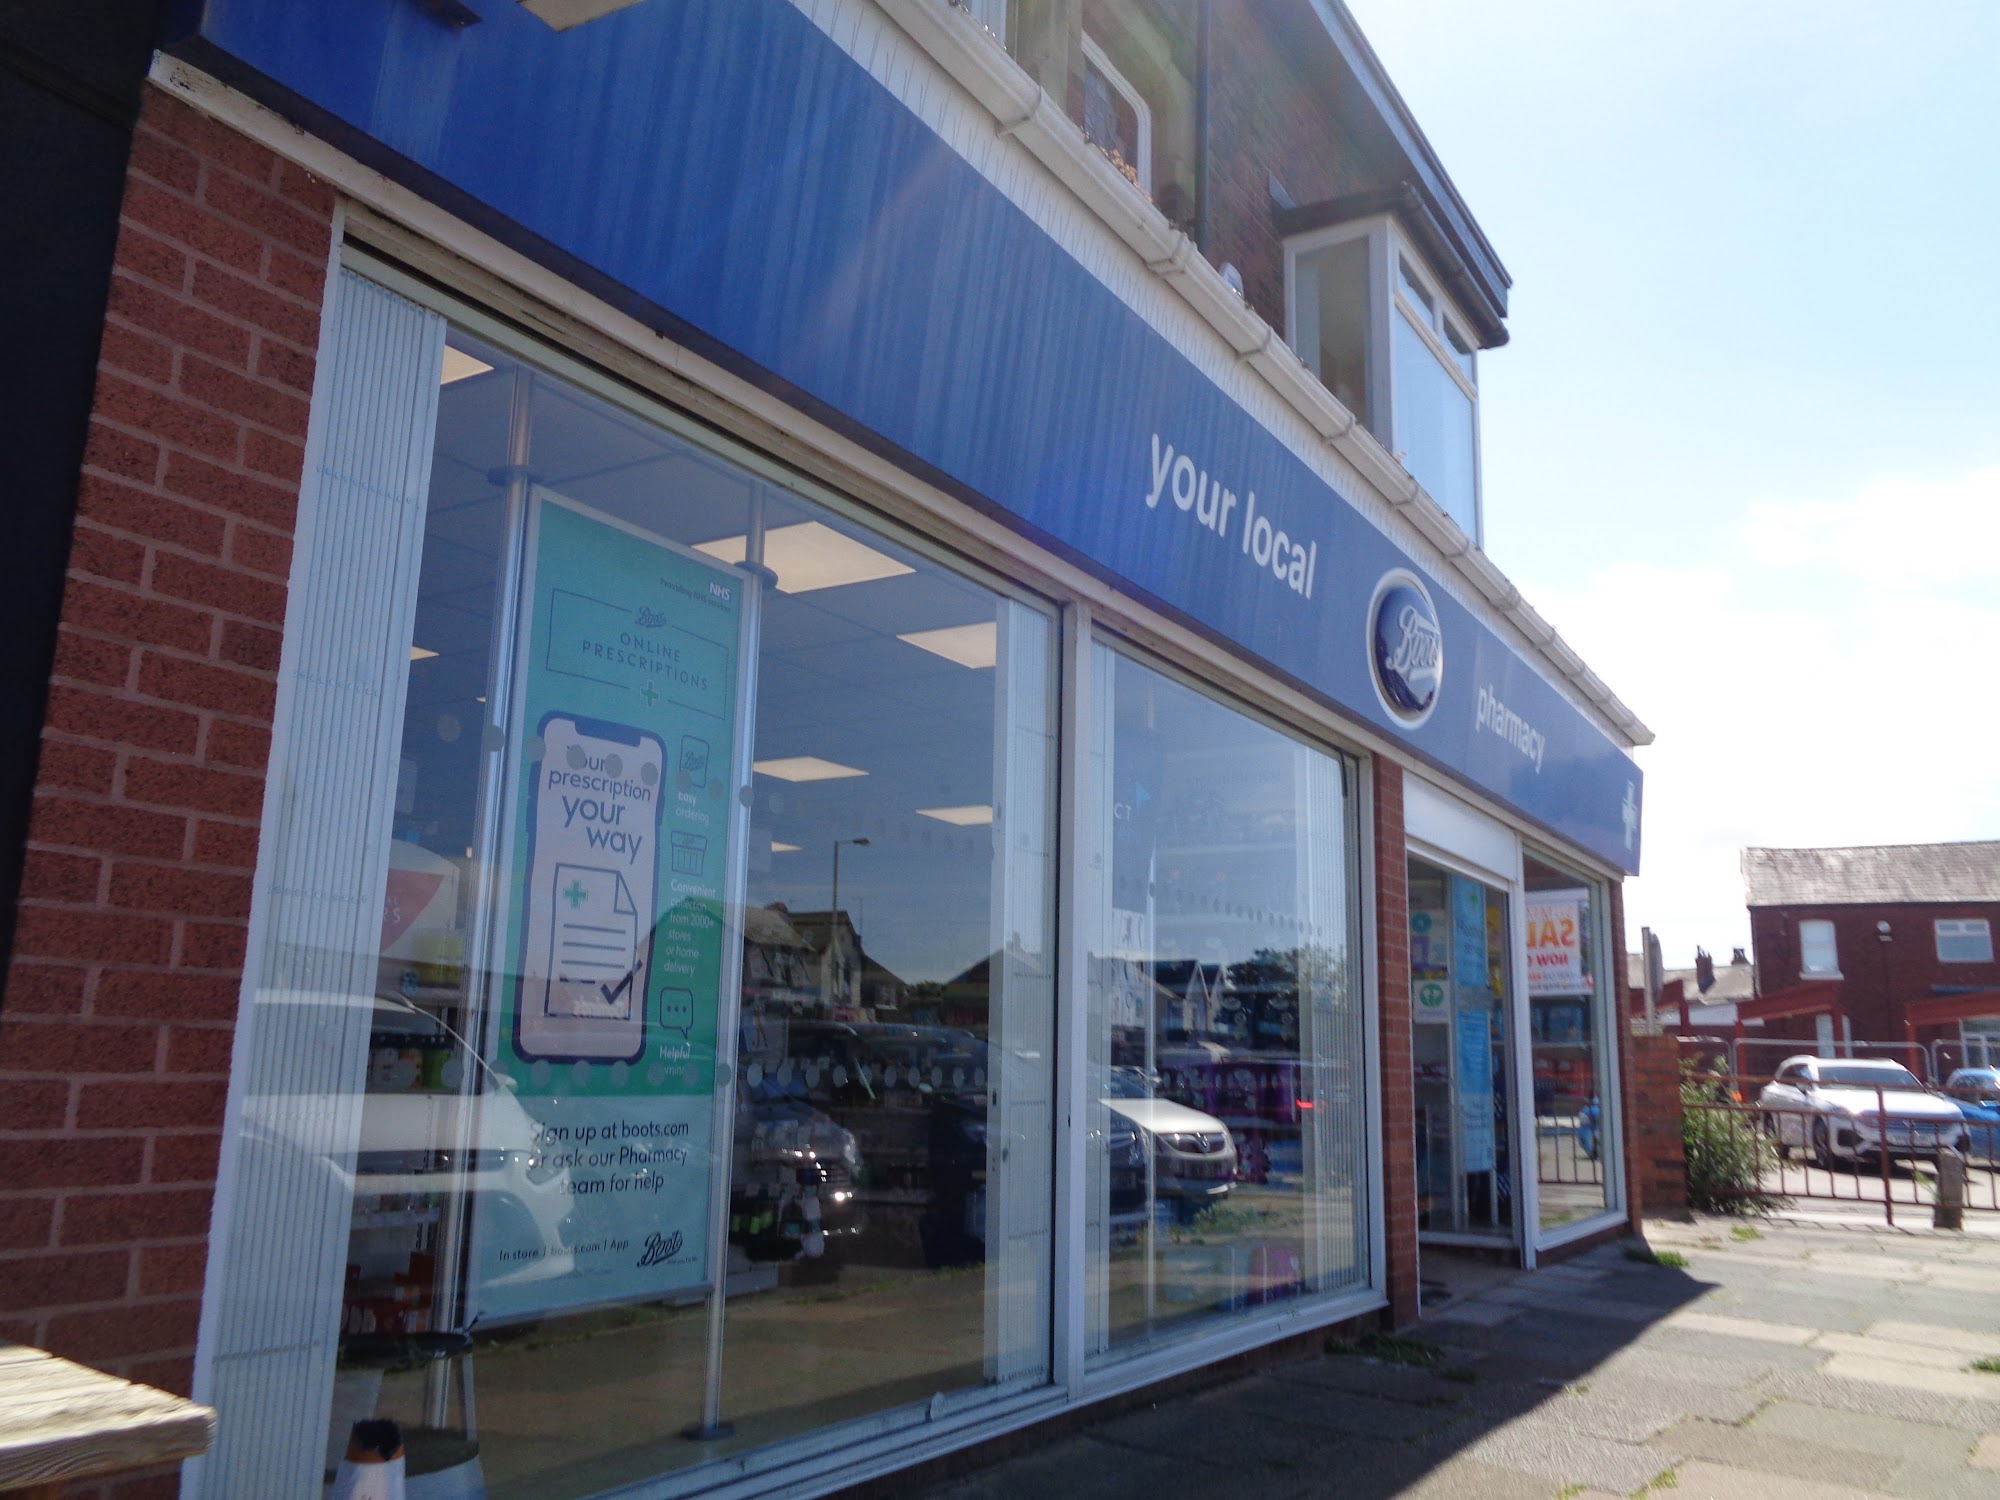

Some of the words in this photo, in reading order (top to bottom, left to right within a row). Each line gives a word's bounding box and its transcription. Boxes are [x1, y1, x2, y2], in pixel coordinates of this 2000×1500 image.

[1145, 433, 1236, 538] your
[1242, 491, 1318, 599] local
[709, 582, 731, 601] NHS
[620, 632, 681, 663] ONLINE
[582, 640, 708, 690] PRESCRIPTIONS
[1475, 682, 1545, 774] pharmacy
[548, 769, 651, 802] prescription
[562, 795, 626, 828] your
[675, 808, 710, 827] ordering
[586, 826, 643, 865] way
[670, 879, 716, 898] Convenient
[670, 912, 689, 925] from
[676, 945, 700, 958] home
[663, 960, 696, 978] delivery
[575, 1125, 597, 1145] up
[601, 1122, 618, 1139] at
[622, 1120, 689, 1138] boots.com
[552, 1150, 583, 1168] ask
[588, 1149, 616, 1166] our
[619, 1145, 688, 1166] Pharmacy
[559, 1176, 605, 1195] team
[610, 1172, 629, 1192] for
[635, 1172, 664, 1194] help
[499, 1250, 510, 1261] In
[512, 1248, 539, 1260] store
[610, 1239, 629, 1252] App
[636, 1230, 683, 1267] Boots
